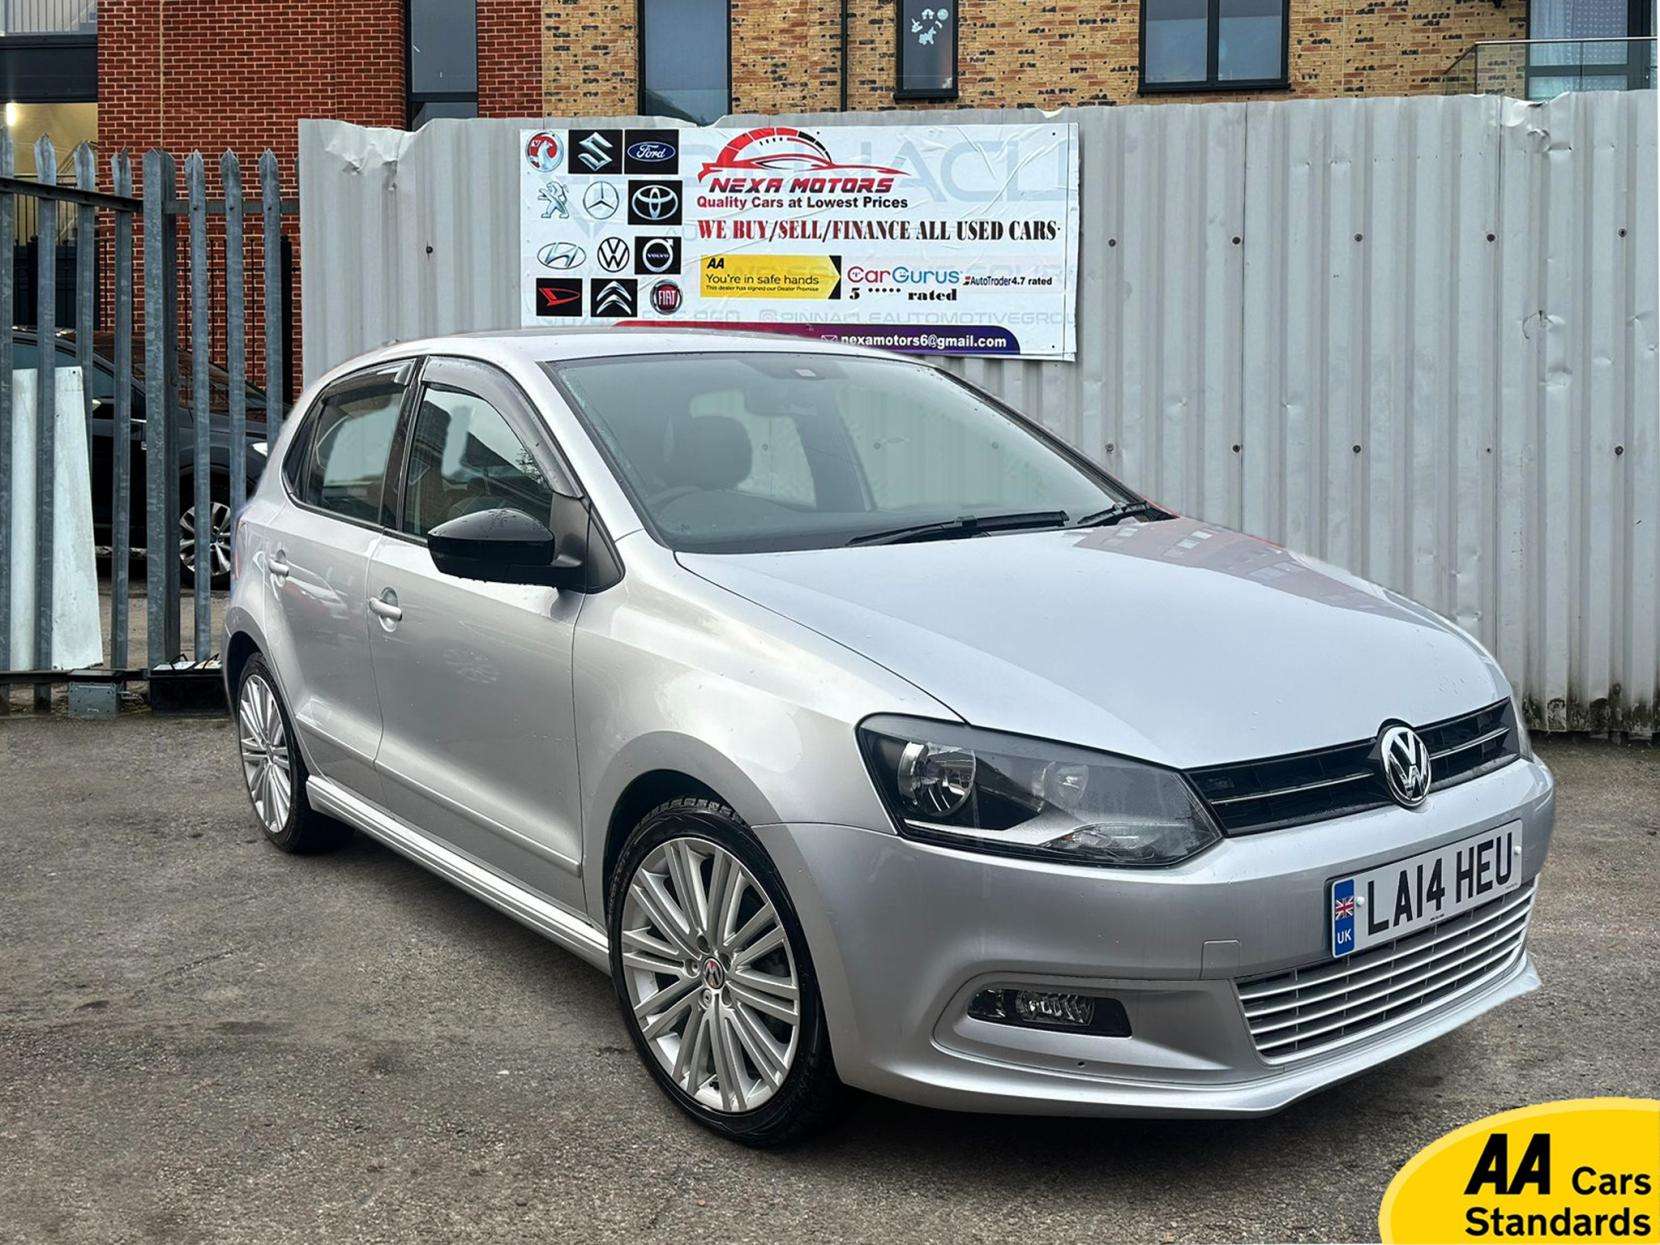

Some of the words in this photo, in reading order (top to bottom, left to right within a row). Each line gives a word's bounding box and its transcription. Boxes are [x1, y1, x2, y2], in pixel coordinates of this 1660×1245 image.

[637, 144, 665, 158] Ford
[709, 177, 784, 193] NEXA
[789, 177, 894, 193] MOTORS
[697, 196, 746, 210] Quality
[752, 196, 784, 208] Cars
[788, 196, 803, 208] at
[807, 196, 859, 208] Lowest
[863, 196, 908, 208] Prices
[698, 220, 727, 240] WE
[733, 220, 910, 242] BUY/SELL/FINANCE
[916, 221, 950, 240] ALL
[957, 221, 1003, 240] USED
[707, 258, 724, 269] AA
[706, 274, 740, 284] You're
[744, 274, 754, 284] in
[757, 274, 781, 284] safe
[784, 275, 819, 285] hands
[847, 266, 960, 284] CarGurus
[1028, 276, 1052, 285] rated
[658, 290, 676, 305] FIAT
[849, 288, 860, 300] 5
[908, 289, 957, 301] rated
[841, 334, 1007, 349] nexamotors6@gmail.com
[1368, 858, 1445, 936] LA14
[1456, 832, 1512, 904] HEU
[1337, 929, 1352, 944] UK
